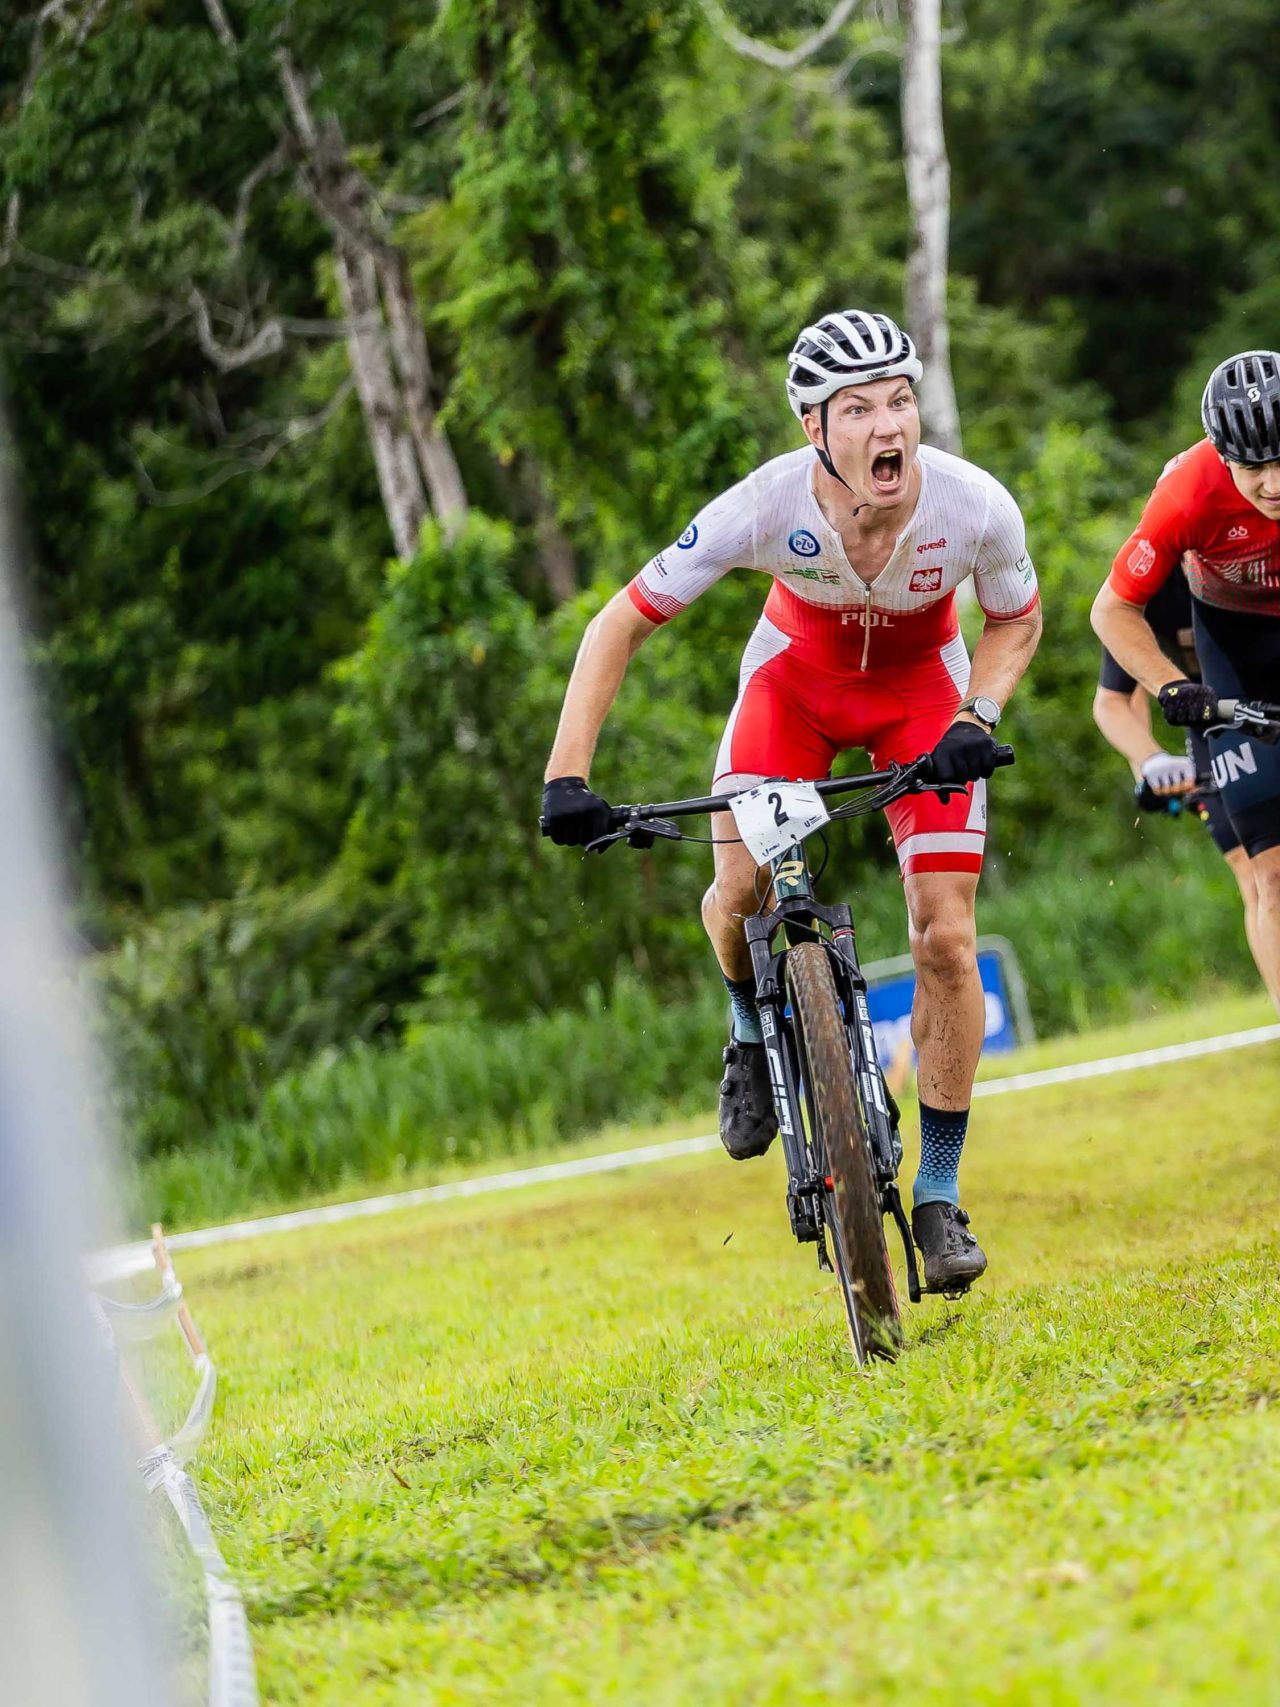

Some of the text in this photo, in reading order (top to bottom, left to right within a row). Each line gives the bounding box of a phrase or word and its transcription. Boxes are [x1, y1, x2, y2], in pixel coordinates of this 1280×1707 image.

[795, 537, 814, 551] PZU
[916, 537, 949, 555] quest
[841, 612, 895, 628] POL
[767, 791, 790, 828] 2
